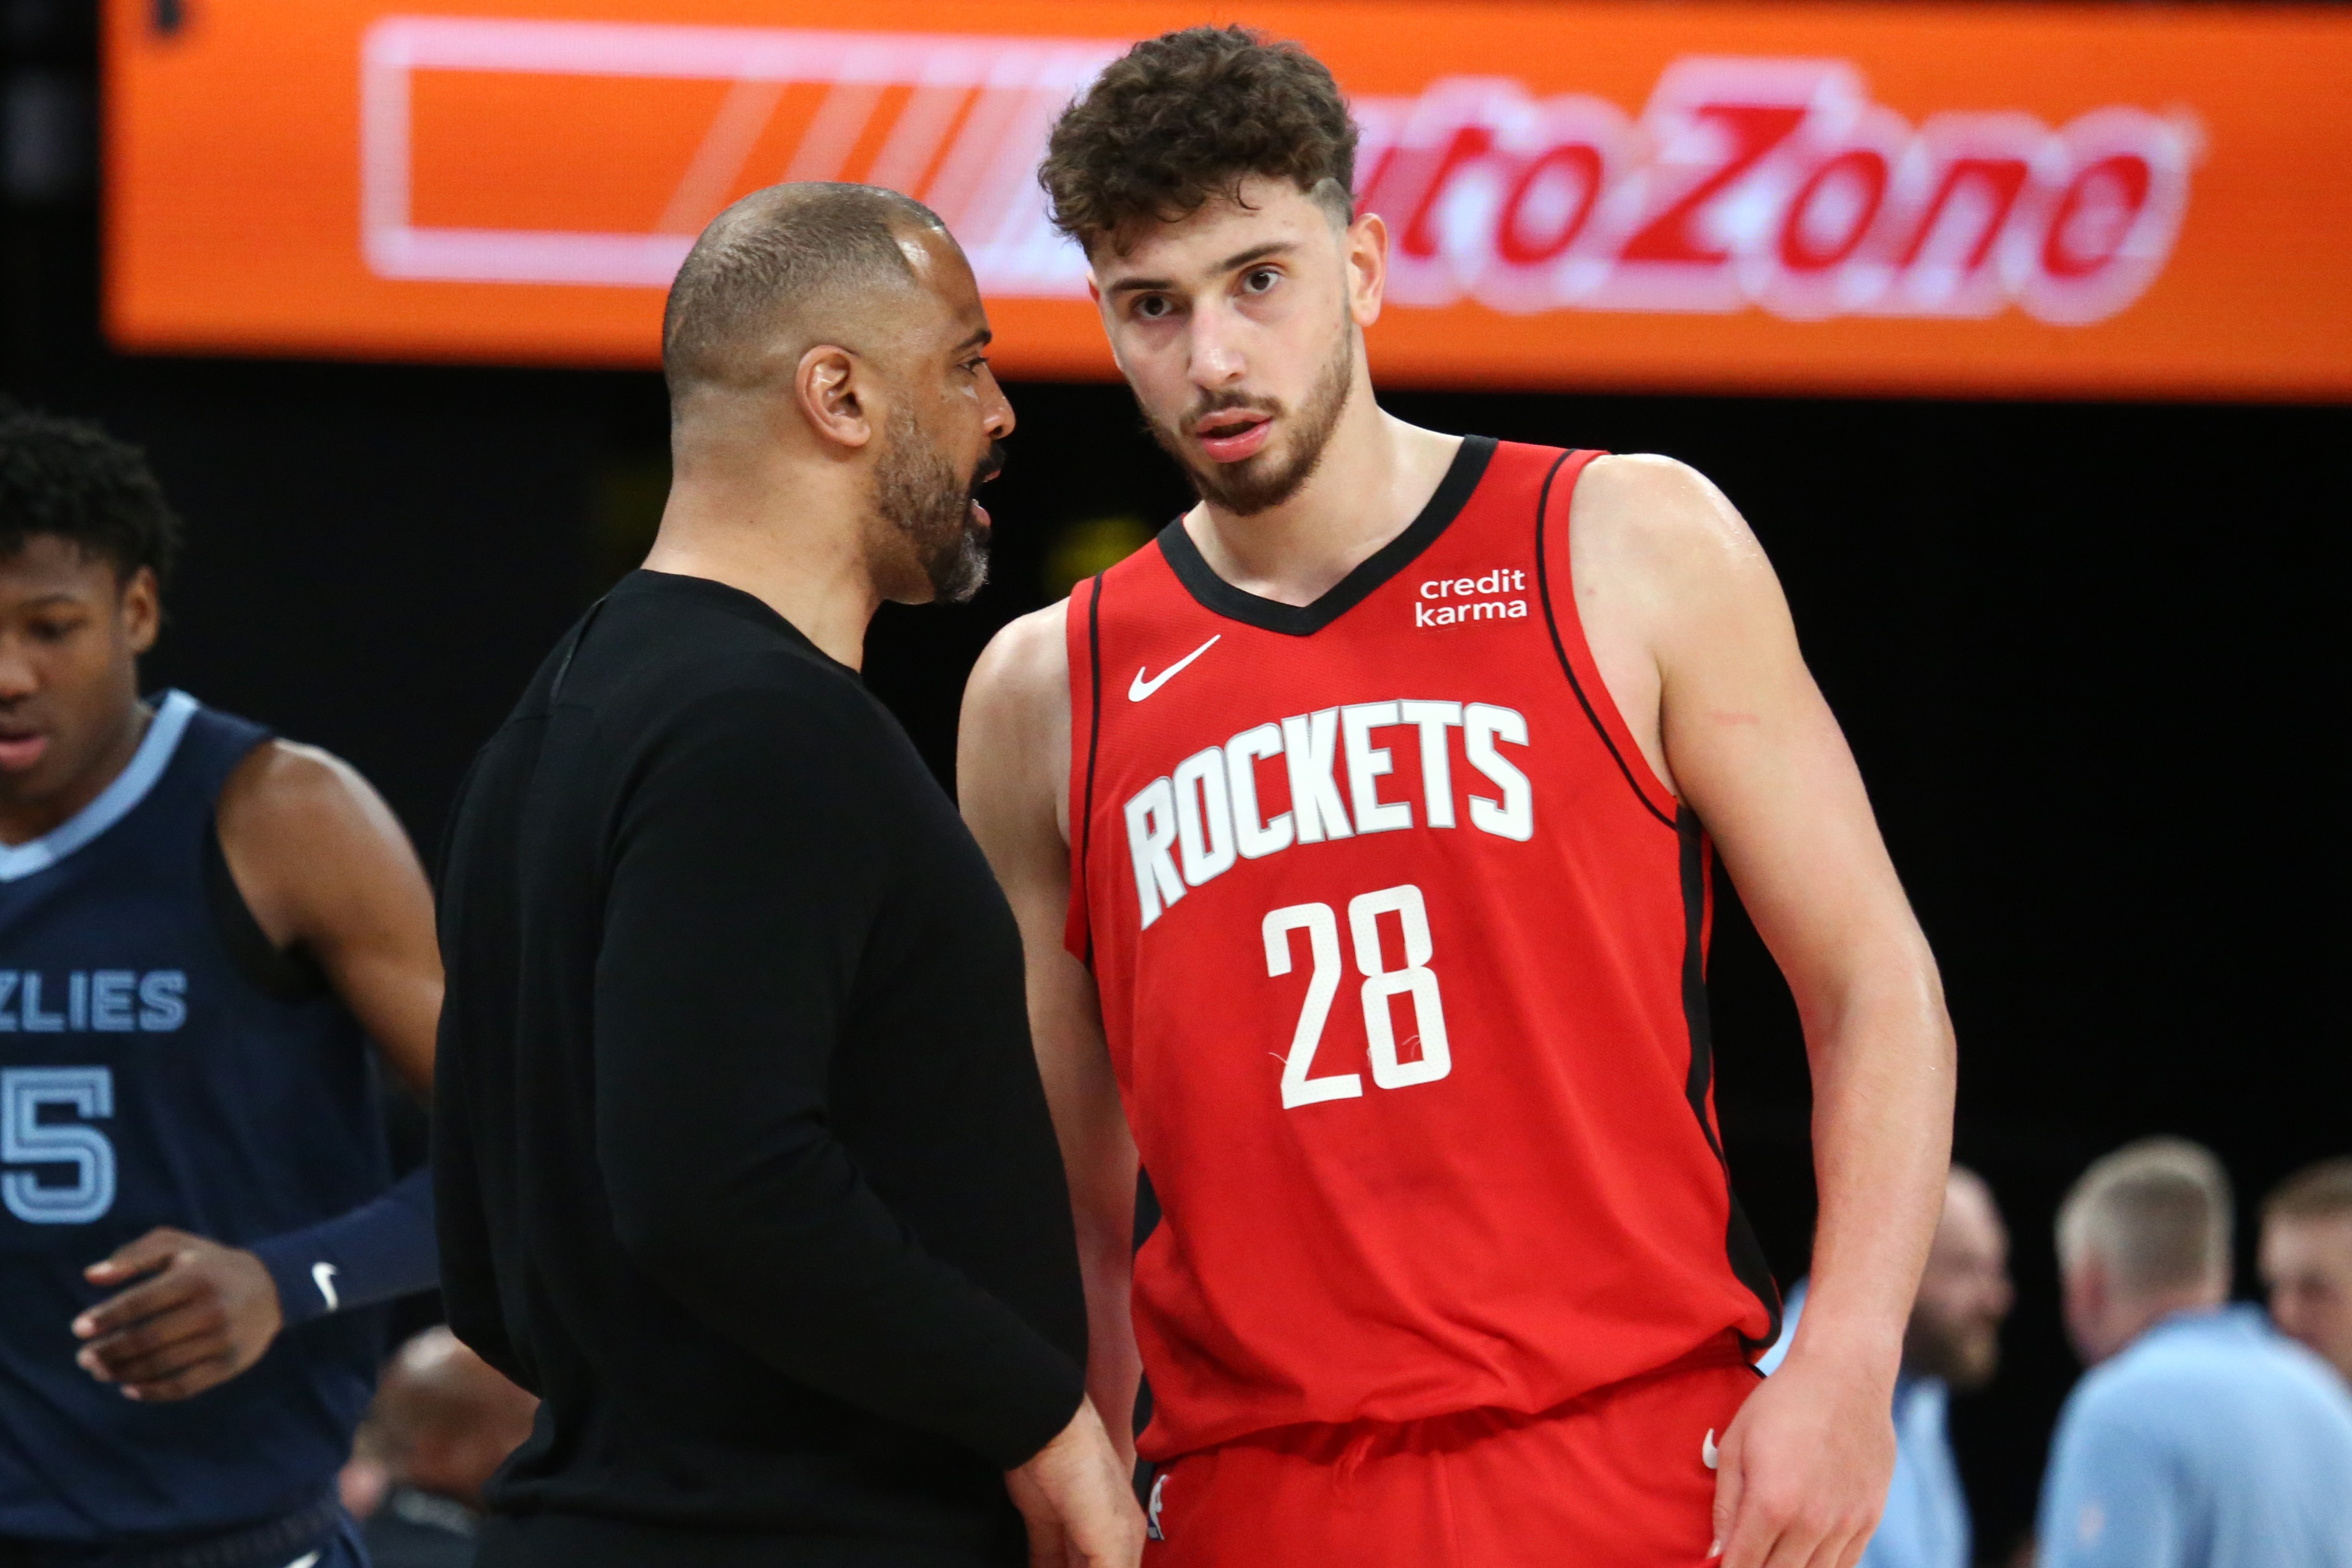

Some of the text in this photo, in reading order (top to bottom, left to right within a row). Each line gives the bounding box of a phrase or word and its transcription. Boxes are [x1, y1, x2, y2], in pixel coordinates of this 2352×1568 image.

[1415, 600, 1528, 627] karma
[1420, 568, 1526, 599] credit
[1123, 698, 1534, 931] ROCKETS
[1262, 884, 1452, 1110] 28
[1, 1065, 117, 1225] 5
